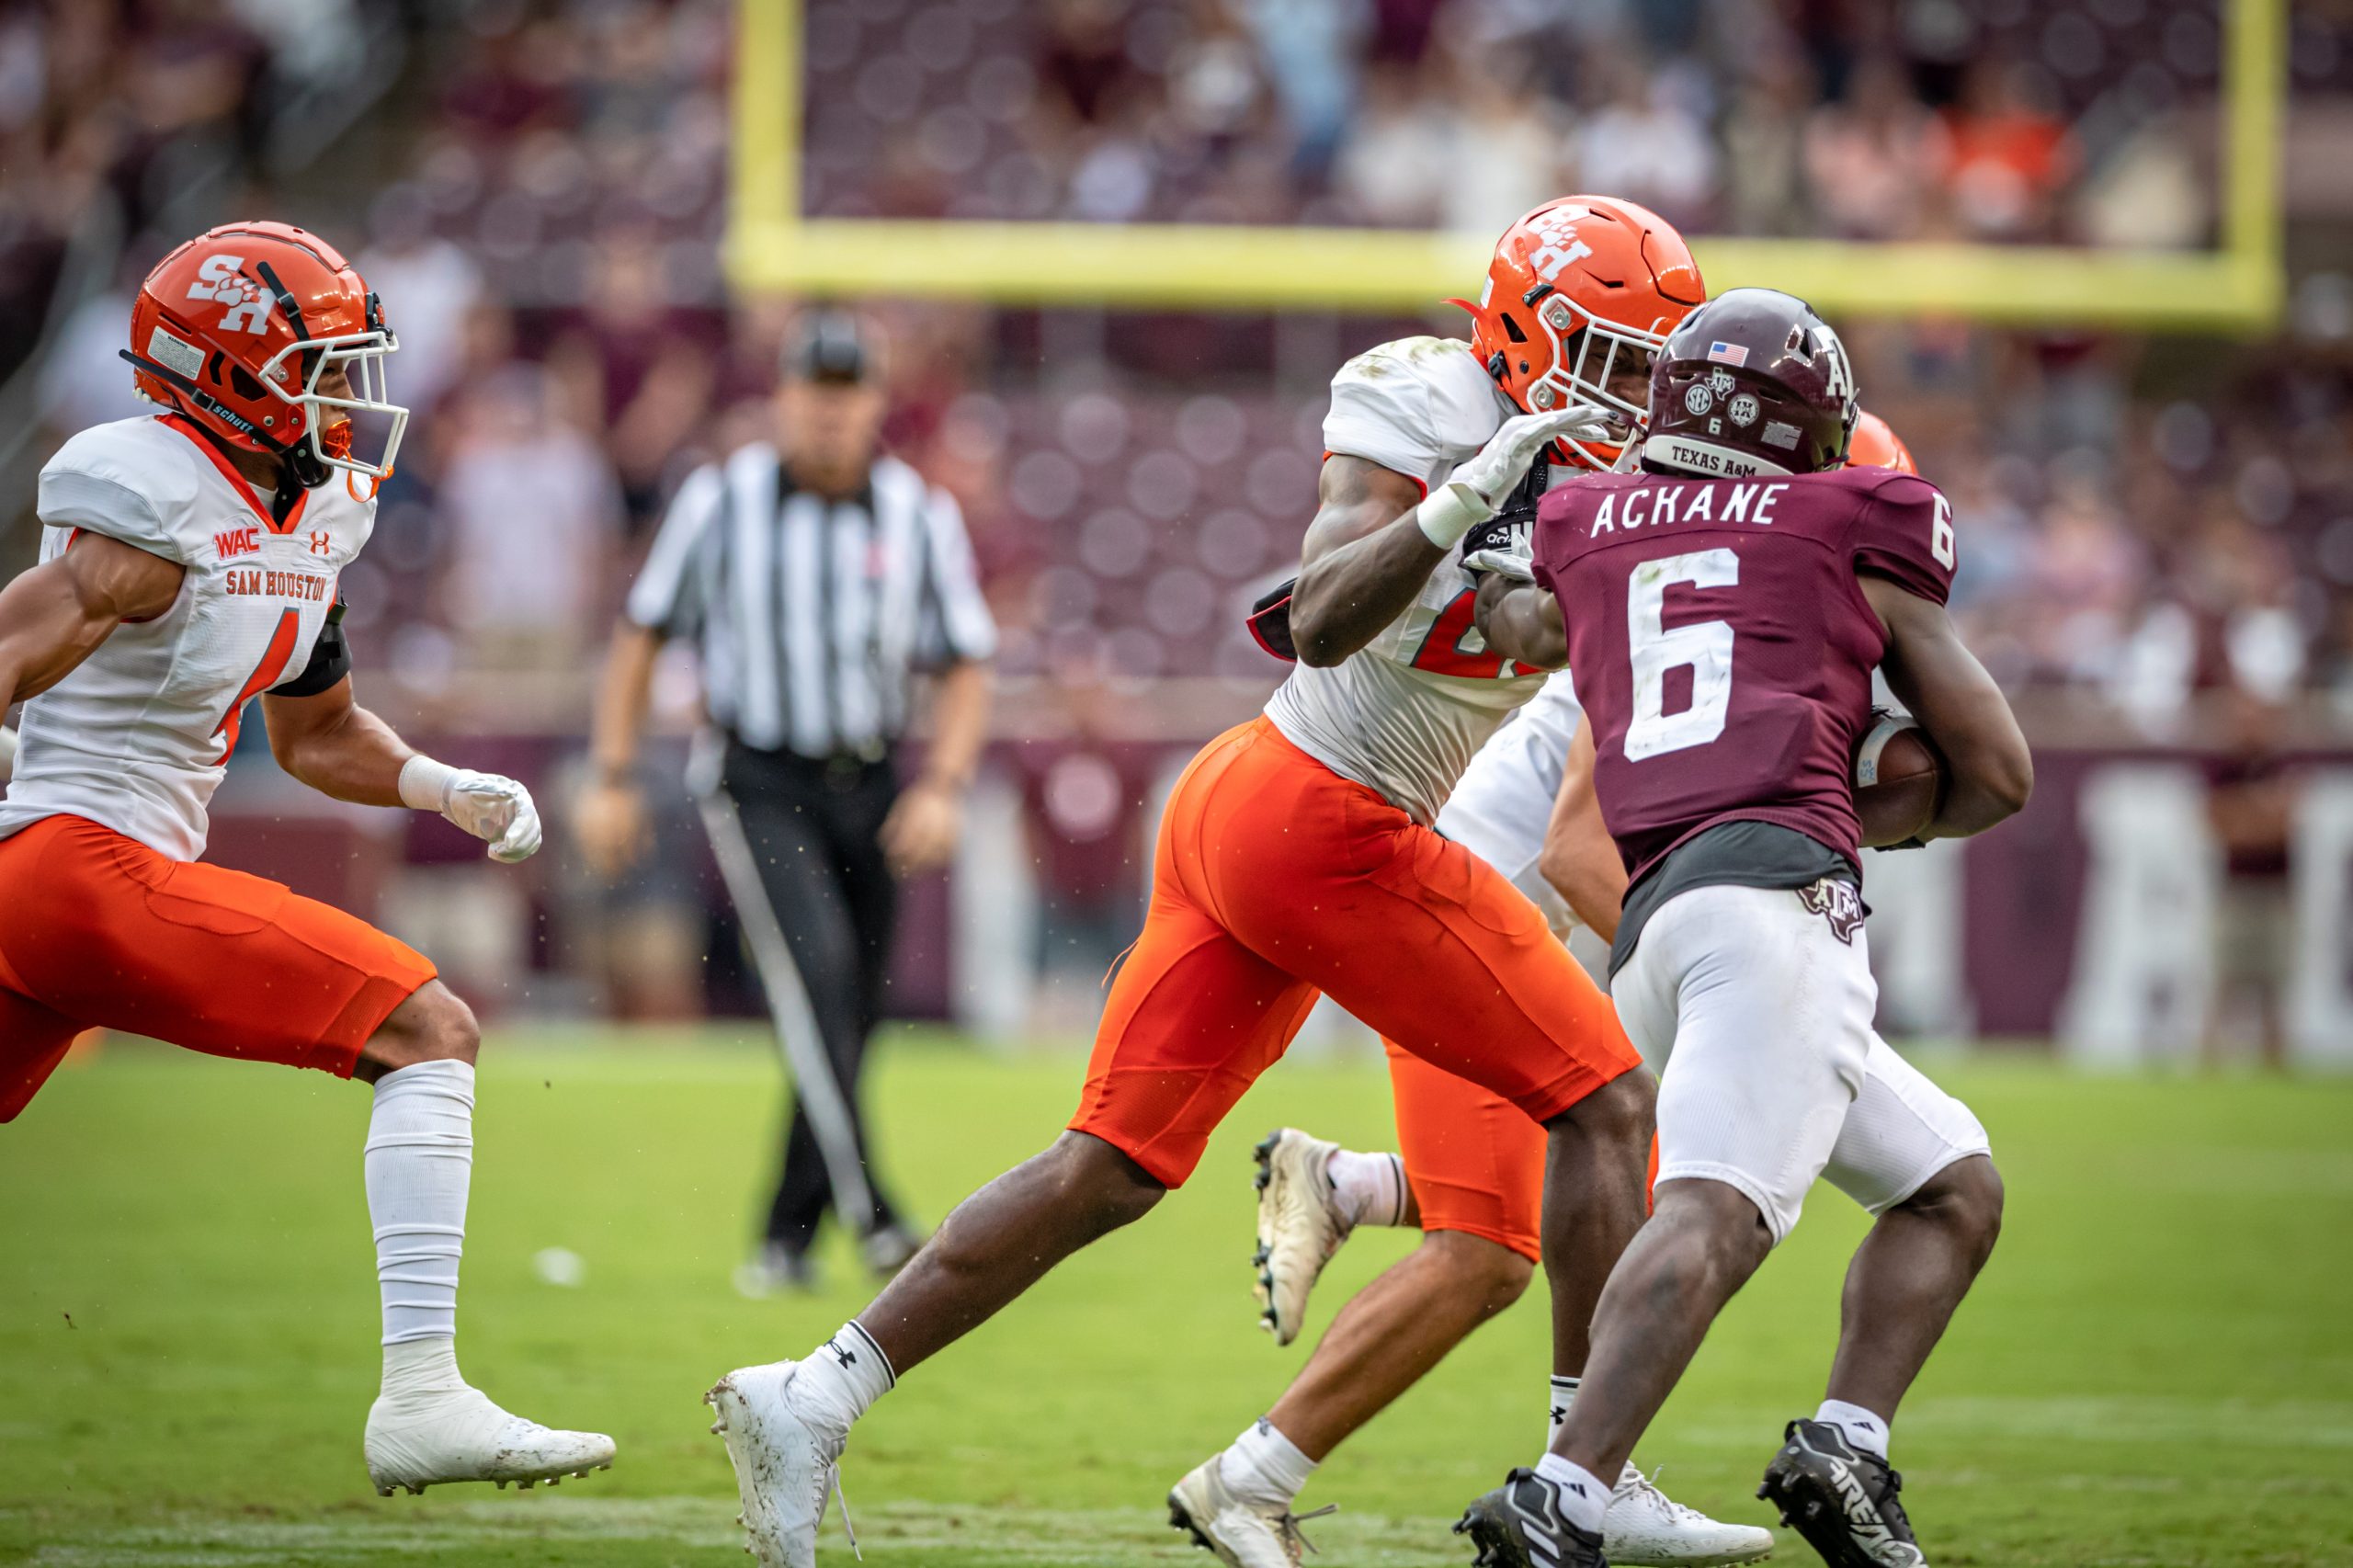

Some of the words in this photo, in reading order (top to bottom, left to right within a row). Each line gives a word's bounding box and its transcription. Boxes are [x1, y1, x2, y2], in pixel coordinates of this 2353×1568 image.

[1688, 385, 1711, 413] SEC
[1708, 417, 1722, 436] 6
[1672, 446, 1720, 472] TEXAS
[1723, 460, 1756, 477] A&M
[1590, 483, 1790, 539] ACHANE
[213, 527, 261, 561] WAC
[1931, 492, 1954, 572] 6
[226, 570, 261, 596] SAM
[266, 570, 327, 602] HOUSTON
[1624, 548, 1739, 763] 6
